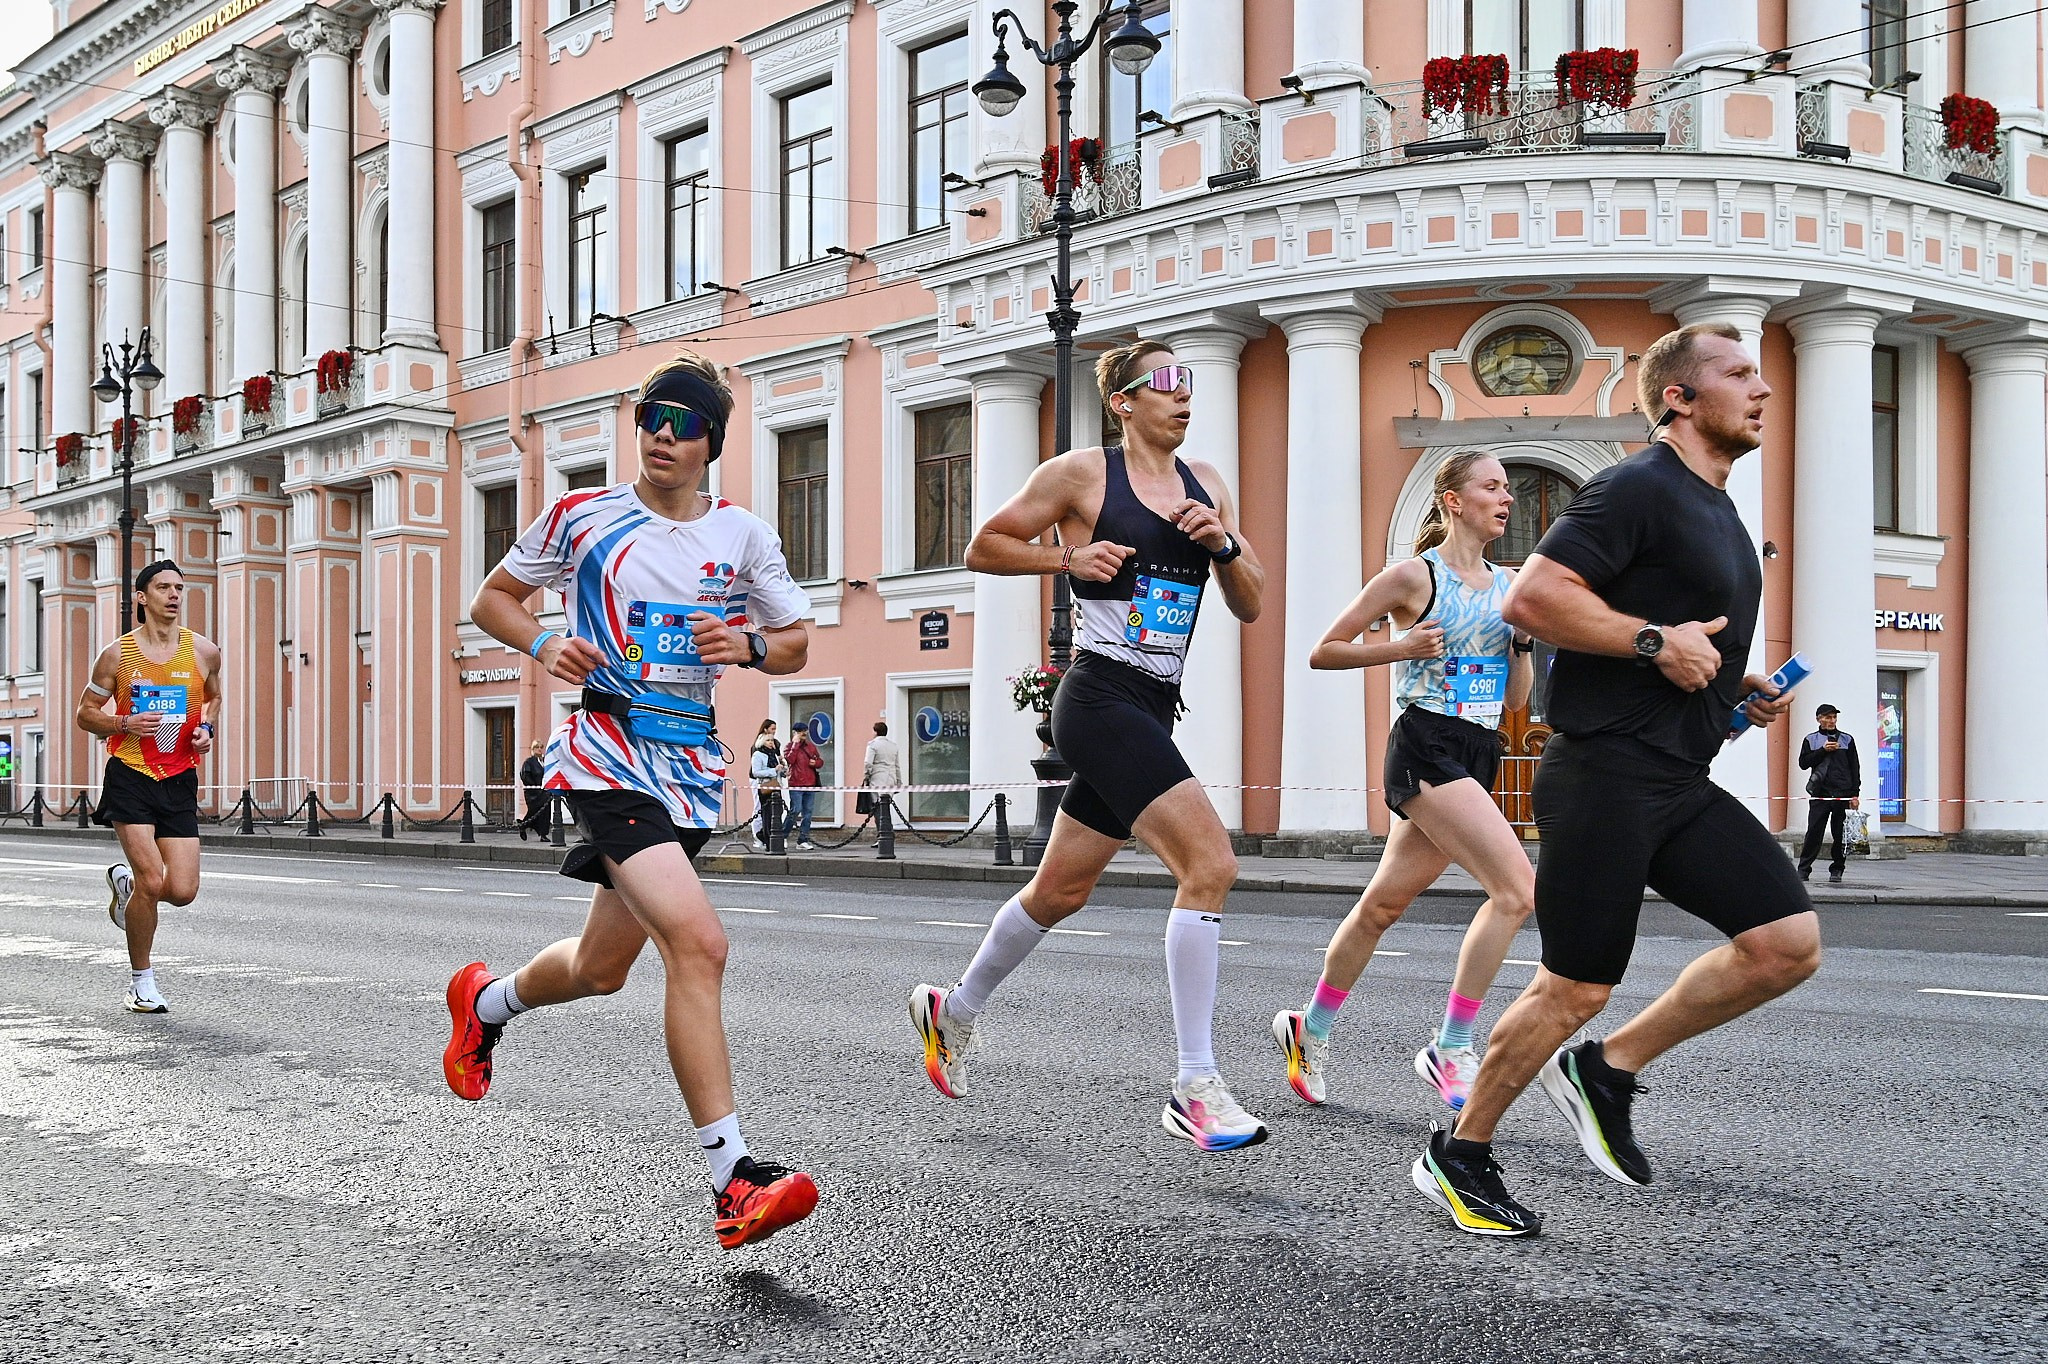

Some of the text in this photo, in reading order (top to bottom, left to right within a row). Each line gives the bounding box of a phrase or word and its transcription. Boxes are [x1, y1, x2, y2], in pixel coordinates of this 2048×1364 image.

[134, 0, 265, 76] БИЗНЕС-ЦЕНТР СЕНА
[1156, 605, 1194, 626] 9024
[1898, 611, 1944, 631] БАНК
[1468, 678, 1497, 695] 6981
[148, 699, 177, 710] 6188
